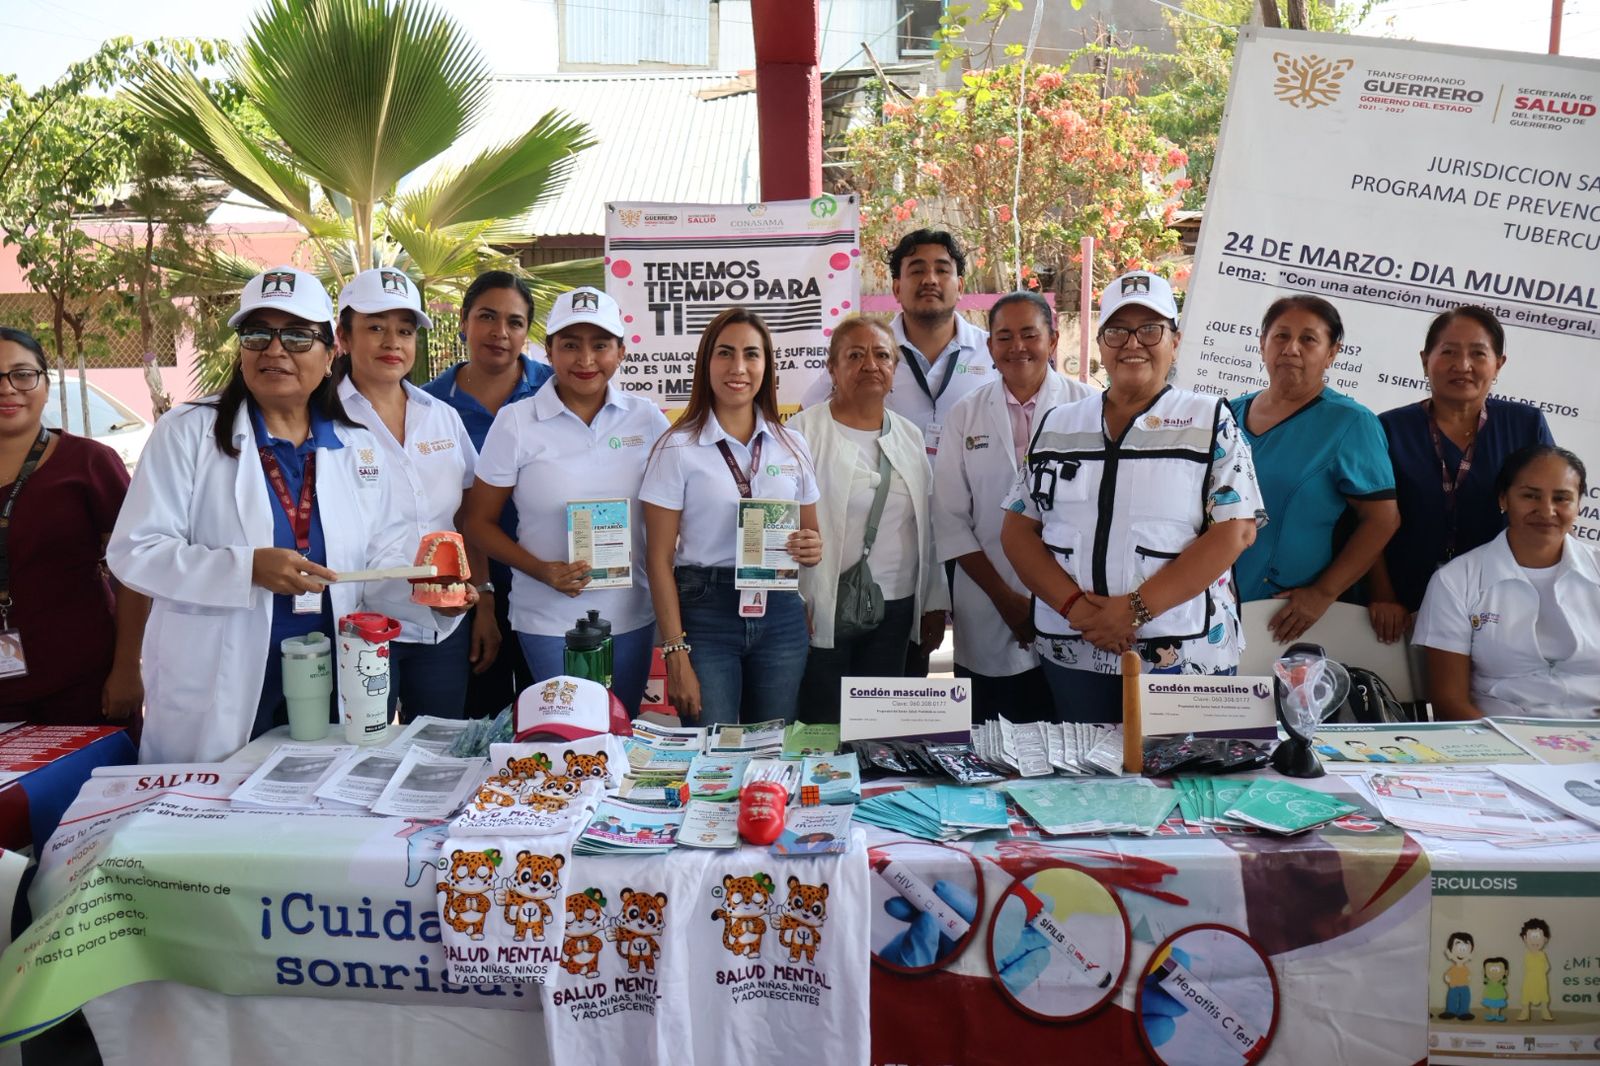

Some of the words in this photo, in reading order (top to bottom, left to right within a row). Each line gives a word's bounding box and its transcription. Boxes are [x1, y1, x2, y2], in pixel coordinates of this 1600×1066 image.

[1366, 69, 1465, 86] TRANSFORMANDO
[1363, 79, 1484, 103] GUERRERO
[1517, 87, 1577, 100] SECRETARÍA
[1360, 95, 1410, 107] GOBIERNO
[1412, 98, 1431, 110] DEL
[1433, 101, 1473, 114] ESTADO
[1513, 97, 1597, 118] SALUD
[1509, 119, 1562, 132] GUERRERO
[1511, 111, 1529, 120] DEL
[1532, 114, 1570, 124] ESTADO
[1572, 118, 1587, 126] DE
[1427, 155, 1572, 189] JURISDICCION
[1351, 174, 1467, 205] PROGRAMA
[1473, 190, 1502, 209] DE
[687, 216, 717, 224] SALUD
[730, 218, 785, 229] CONASAMA
[1503, 222, 1600, 251] TUBERCU
[643, 259, 760, 281] TENEMOS
[1224, 231, 1254, 254] 24
[1260, 238, 1293, 261] DE
[1299, 244, 1403, 279] MARZO:
[1410, 261, 1456, 288] DIA
[1464, 269, 1599, 309] MUNDIAL
[644, 281, 749, 303] TIEMPO
[753, 276, 822, 300] PARA
[1218, 261, 1267, 281] Lema:
[1279, 271, 1316, 288] "Con
[1320, 280, 1349, 293] una
[1353, 284, 1421, 305] atención
[1426, 294, 1511, 319] humaista
[1516, 309, 1597, 335] eintegral,
[648, 303, 683, 336] TI
[1206, 321, 1236, 334] ¿QUE
[1240, 325, 1252, 336] ES
[1203, 336, 1214, 346] Es
[620, 365, 638, 375] NO
[644, 365, 658, 375] ES
[664, 364, 682, 374] UN
[1200, 351, 1252, 369] Infecciosa
[1258, 363, 1265, 373] y
[620, 380, 653, 391] TODO
[1197, 367, 1208, 377] se
[1218, 370, 1269, 388] transmite
[1336, 377, 1359, 390] que
[1377, 372, 1389, 384] SI
[1193, 382, 1228, 397] gotitas
[1540, 401, 1579, 418] ESTOS
[1163, 417, 1193, 426] Salud
[432, 442, 455, 453] SALUD
[849, 687, 891, 698] Condón
[893, 687, 947, 698] masculino
[1148, 683, 1191, 693] Condón
[1193, 684, 1249, 694] masculino
[135, 772, 220, 792] SALUD
[156, 808, 193, 820] sirven
[213, 883, 231, 895] de
[66, 892, 136, 917] organismo,
[261, 891, 441, 942] ¡Cuida
[64, 927, 75, 937] a
[79, 920, 91, 933] tu
[1039, 917, 1066, 944] SÍFILIS
[35, 948, 74, 968] hasta
[76, 934, 106, 956] para
[497, 946, 562, 964] MENTAL
[454, 964, 478, 973] PARA
[481, 963, 512, 976] NIÑAS,
[515, 964, 548, 974] NIÑOS
[716, 965, 766, 986] SALUD
[774, 965, 831, 990] MENTAL
[455, 975, 461, 983] Y
[463, 974, 546, 985] ADOLESCENTES
[732, 982, 756, 995] PARA
[758, 979, 791, 991] NIÑAS,
[793, 984, 821, 997] NIÑOS
[1562, 976, 1580, 986] es
[553, 983, 607, 1006] SALUD
[733, 995, 739, 1005] Y
[741, 989, 820, 1007] ADOLESCENTES
[1562, 994, 1591, 1004] con
[570, 999, 598, 1013] PARA
[599, 994, 633, 1008] NIÑAS,
[1172, 973, 1221, 1020] Hepatitis
[1221, 1016, 1235, 1029] C
[1232, 1024, 1255, 1048] Test
[572, 1013, 580, 1022] Y
